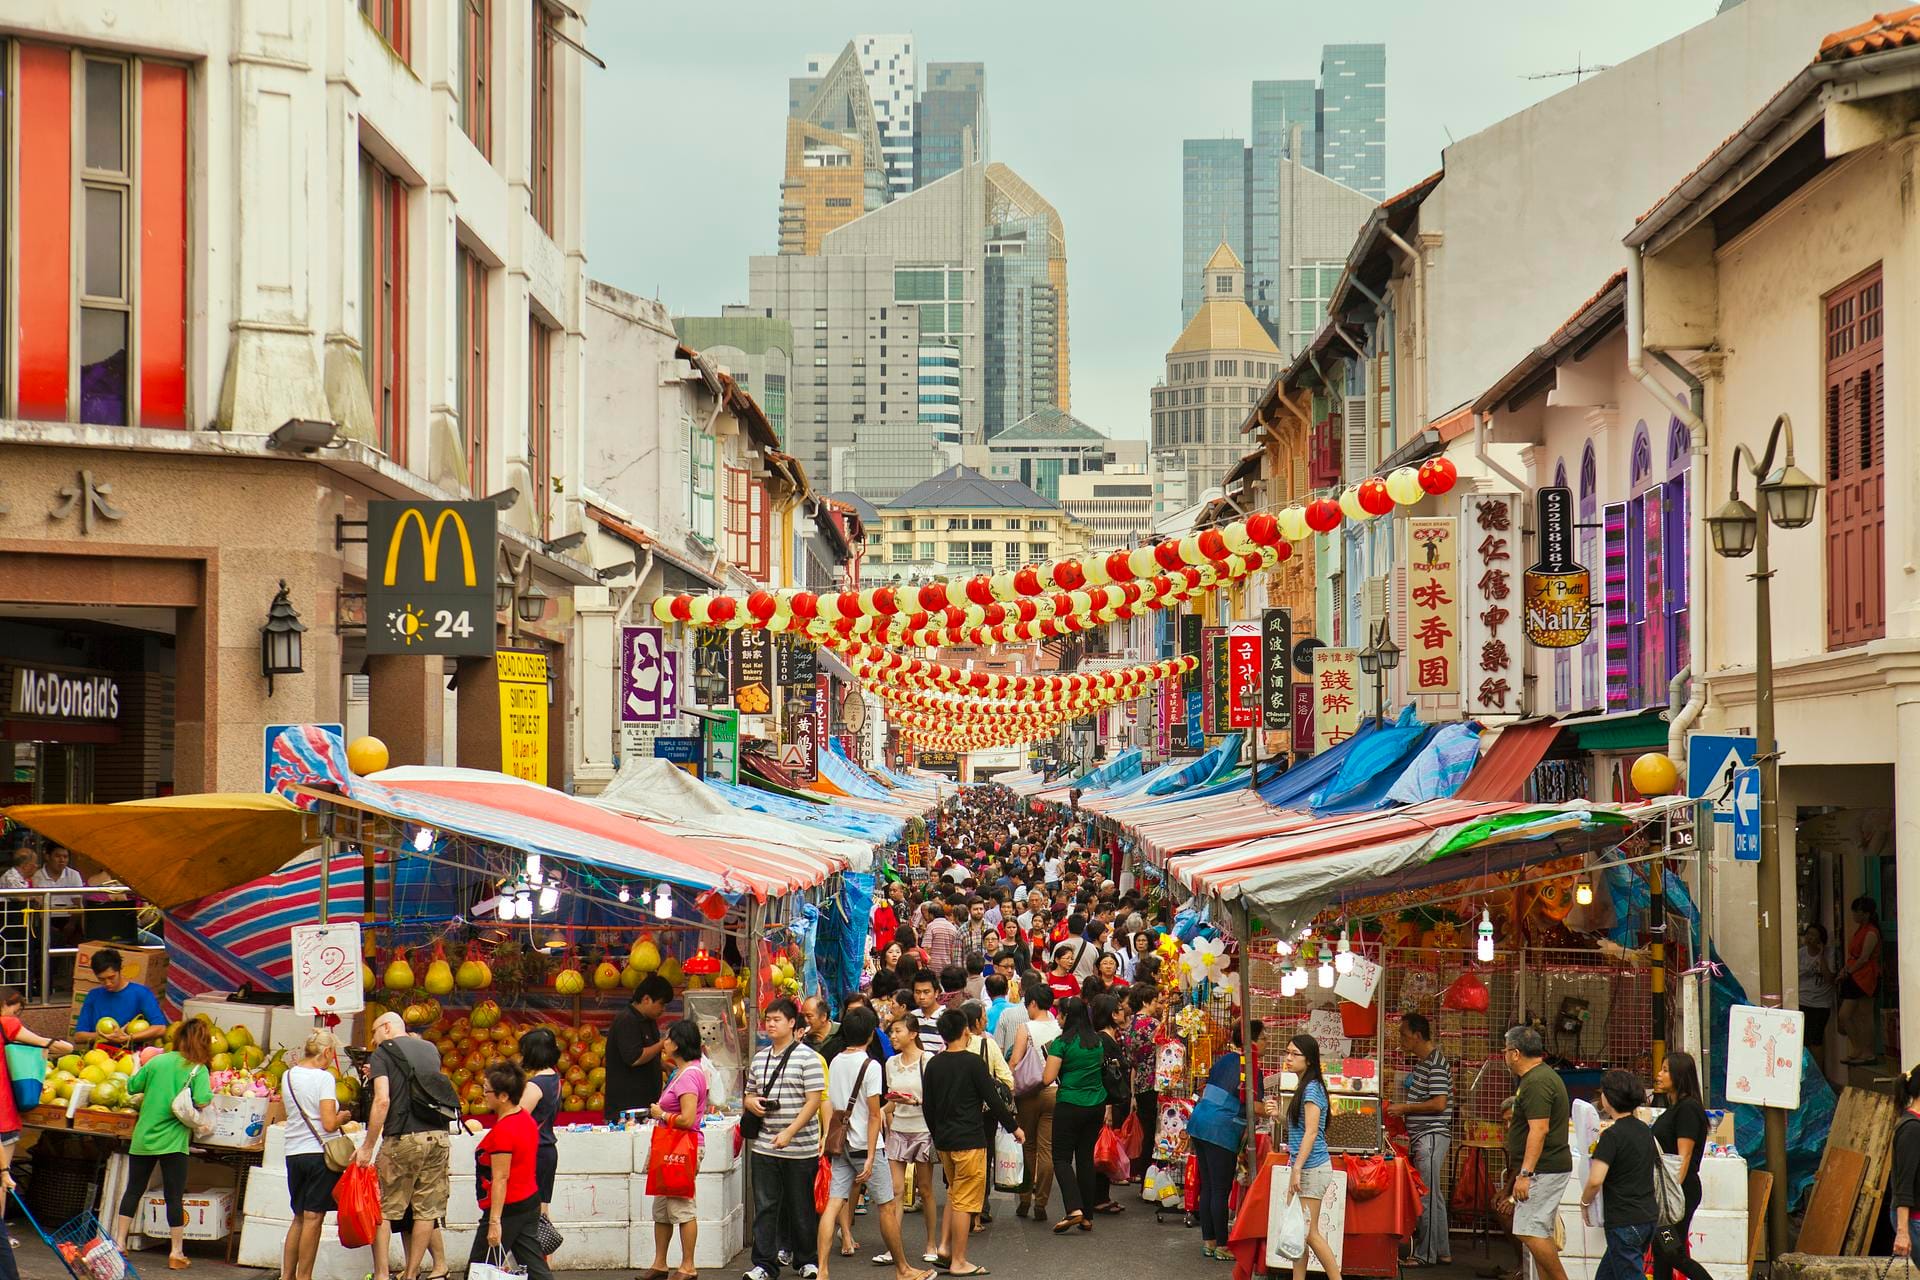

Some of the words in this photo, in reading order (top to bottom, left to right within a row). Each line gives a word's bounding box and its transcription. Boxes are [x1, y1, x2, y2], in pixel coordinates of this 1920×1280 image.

[48, 469, 128, 534] 水
[1547, 492, 1561, 572] 62238387
[434, 610, 474, 638] 24
[1529, 606, 1588, 631] Nailz
[518, 656, 547, 679] CLOSURE
[1269, 618, 1285, 708] 风波庄酒家
[19, 668, 119, 719] McDonald's
[510, 687, 528, 708] SMITH
[512, 739, 519, 758] 10
[520, 739, 530, 758] Jan
